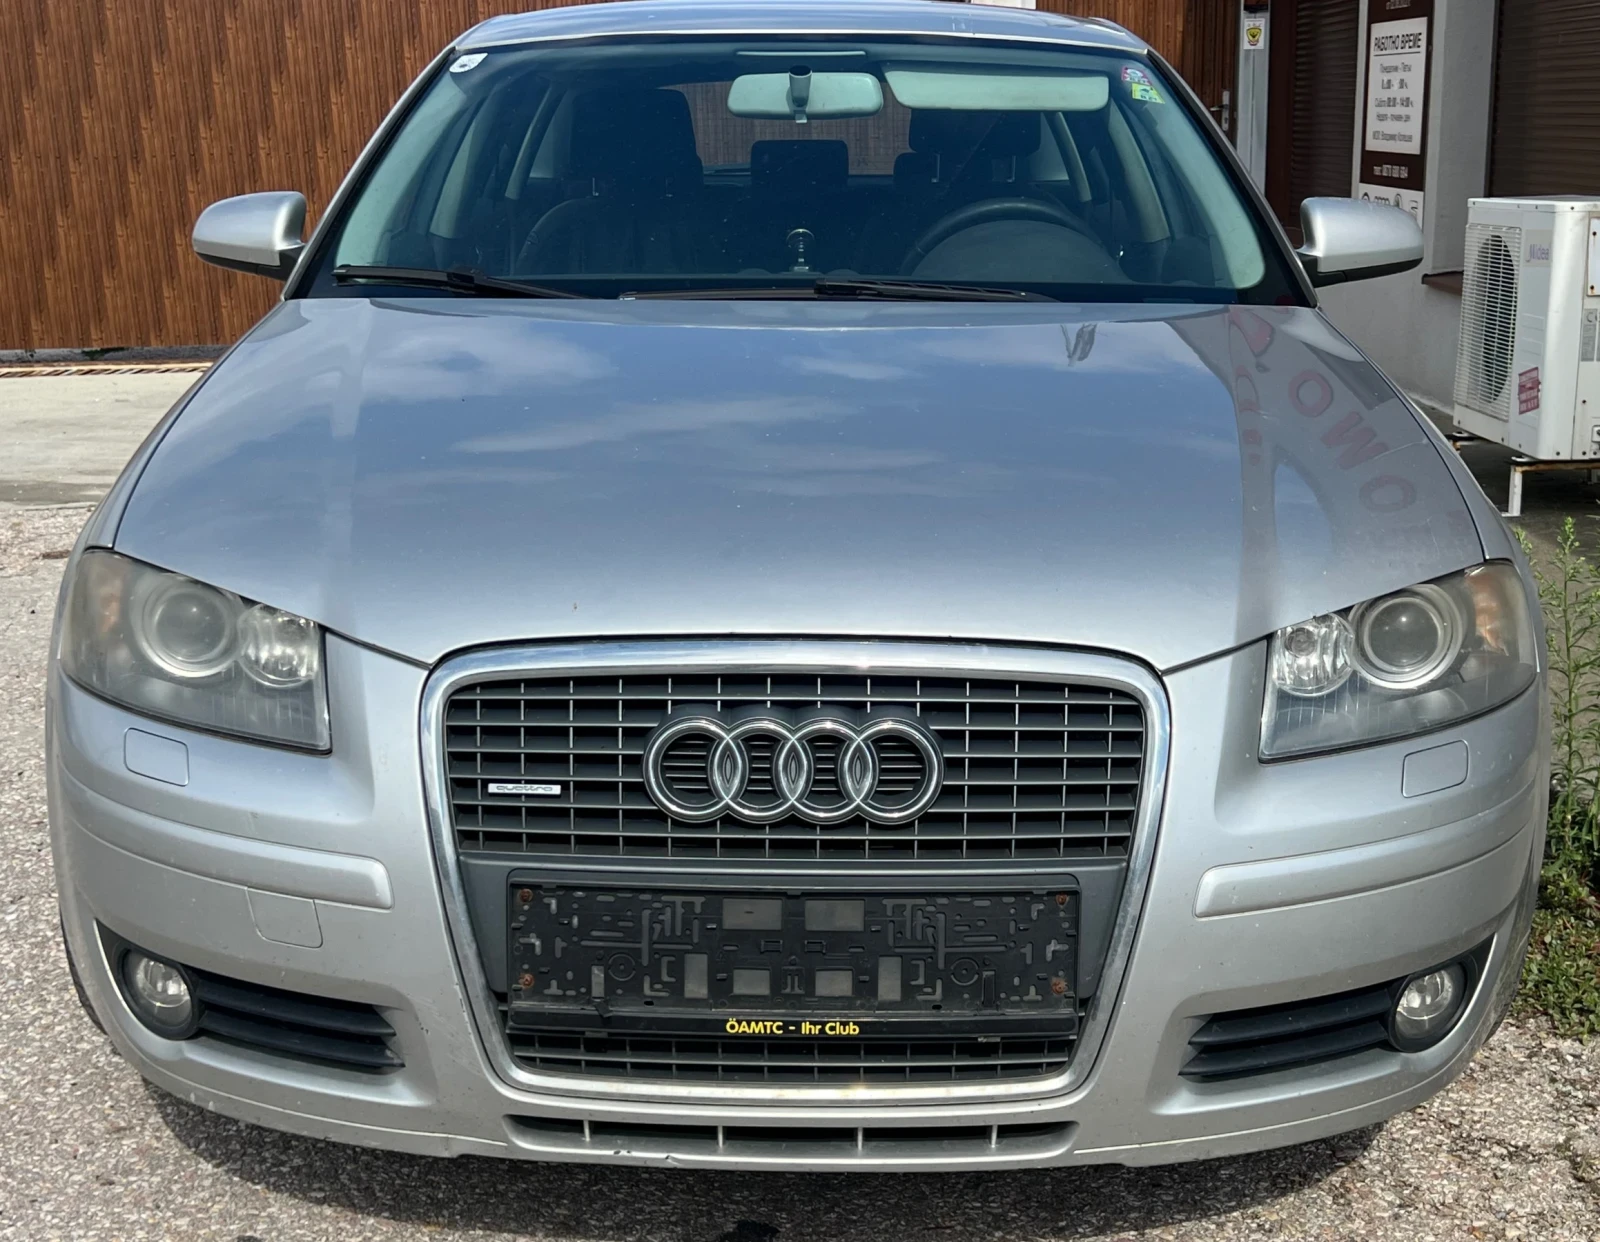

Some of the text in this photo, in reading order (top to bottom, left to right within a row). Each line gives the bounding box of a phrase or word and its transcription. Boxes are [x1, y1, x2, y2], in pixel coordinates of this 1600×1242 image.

[1373, 32, 1422, 51] РАБОТНО ВРЕМЕ
[726, 1018, 784, 1034] ÖAMTC
[801, 1021, 822, 1034] Ihr
[825, 1022, 860, 1035] Club
